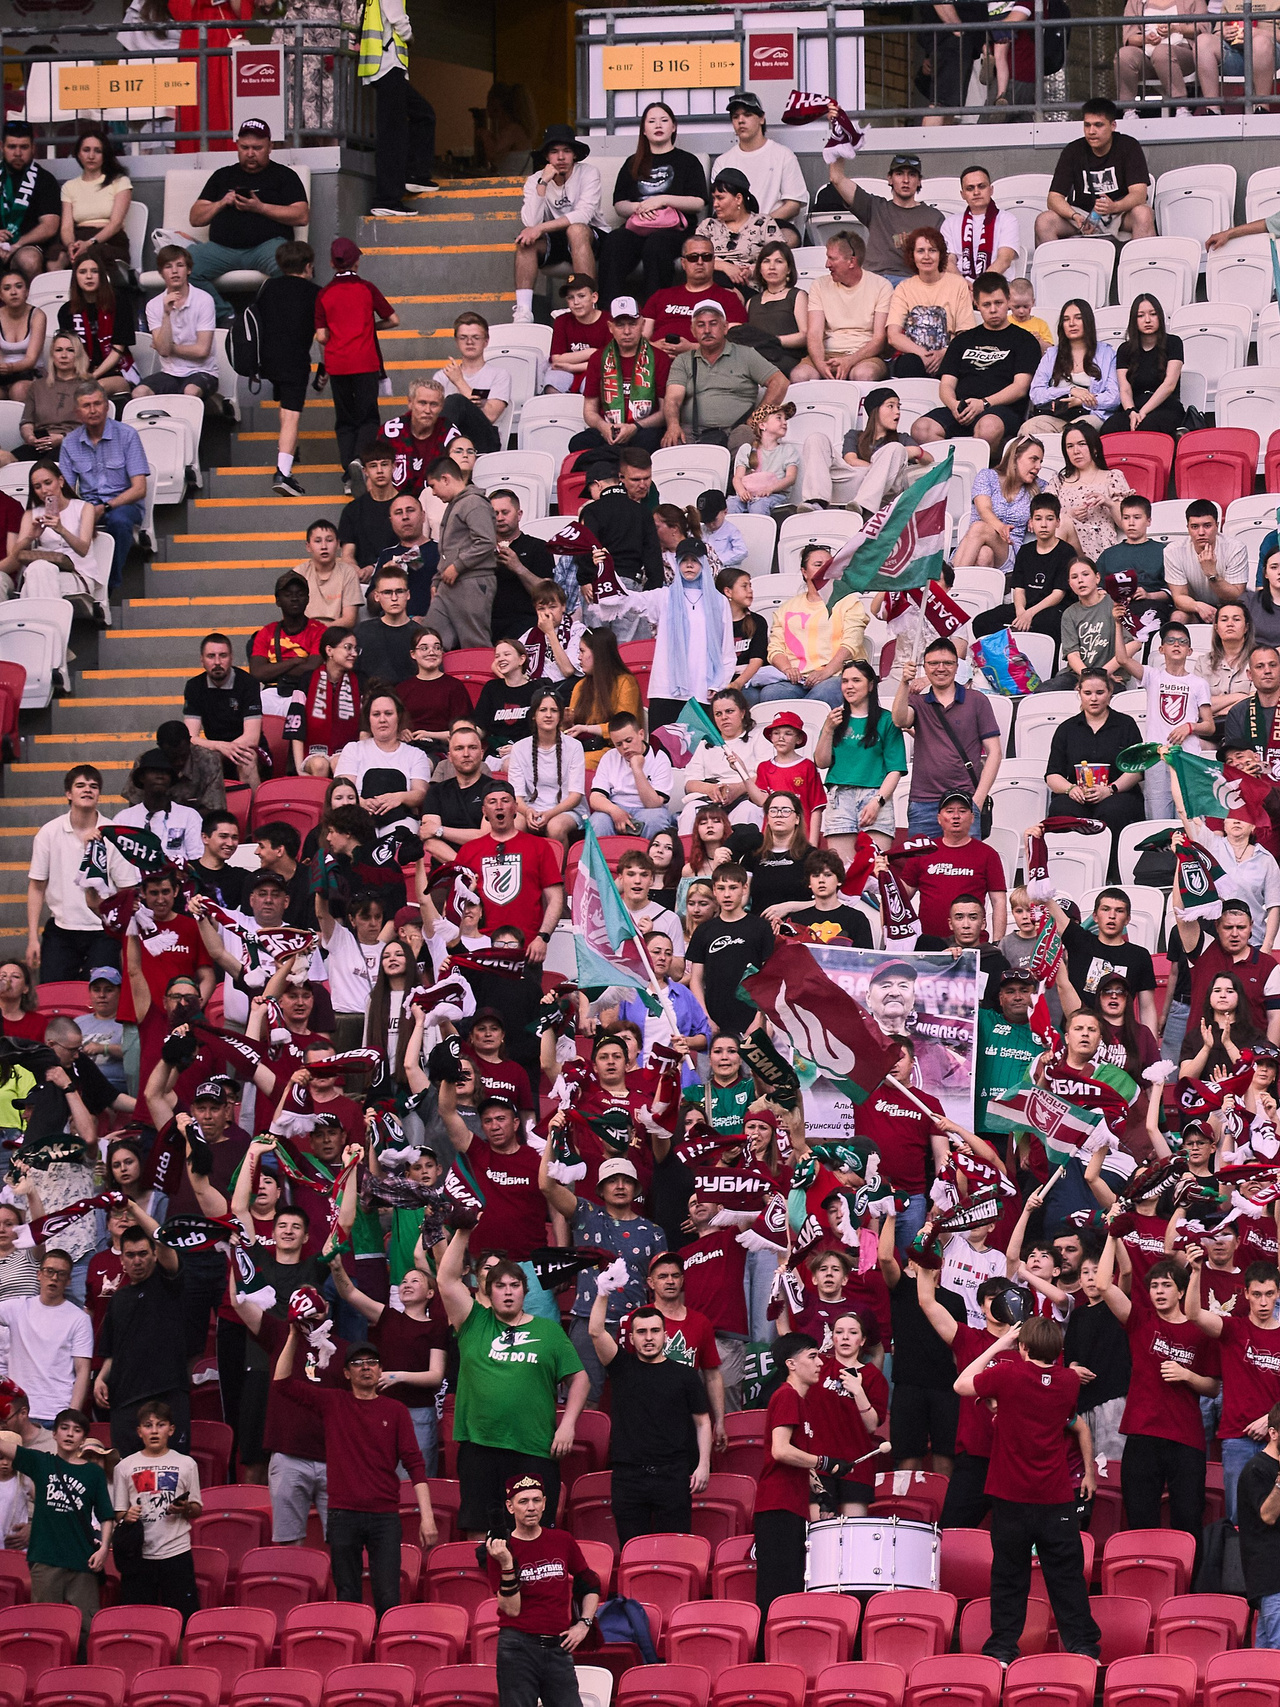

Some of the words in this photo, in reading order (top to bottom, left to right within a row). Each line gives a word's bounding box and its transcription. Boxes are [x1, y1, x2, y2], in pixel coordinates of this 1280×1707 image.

[652, 61, 664, 73] B
[667, 60, 690, 72] 116
[109, 80, 121, 93] B
[125, 79, 144, 92] 117
[966, 350, 1005, 362] Dickies
[1078, 621, 1104, 639] Chill
[936, 867, 974, 877] РУБИН
[999, 1051, 1034, 1062] ОРГСИНТ
[1000, 1046, 1032, 1056] КАЗАНЬ
[488, 1349, 509, 1362] JUST
[510, 1352, 526, 1362] DO
[527, 1353, 538, 1364] IT.
